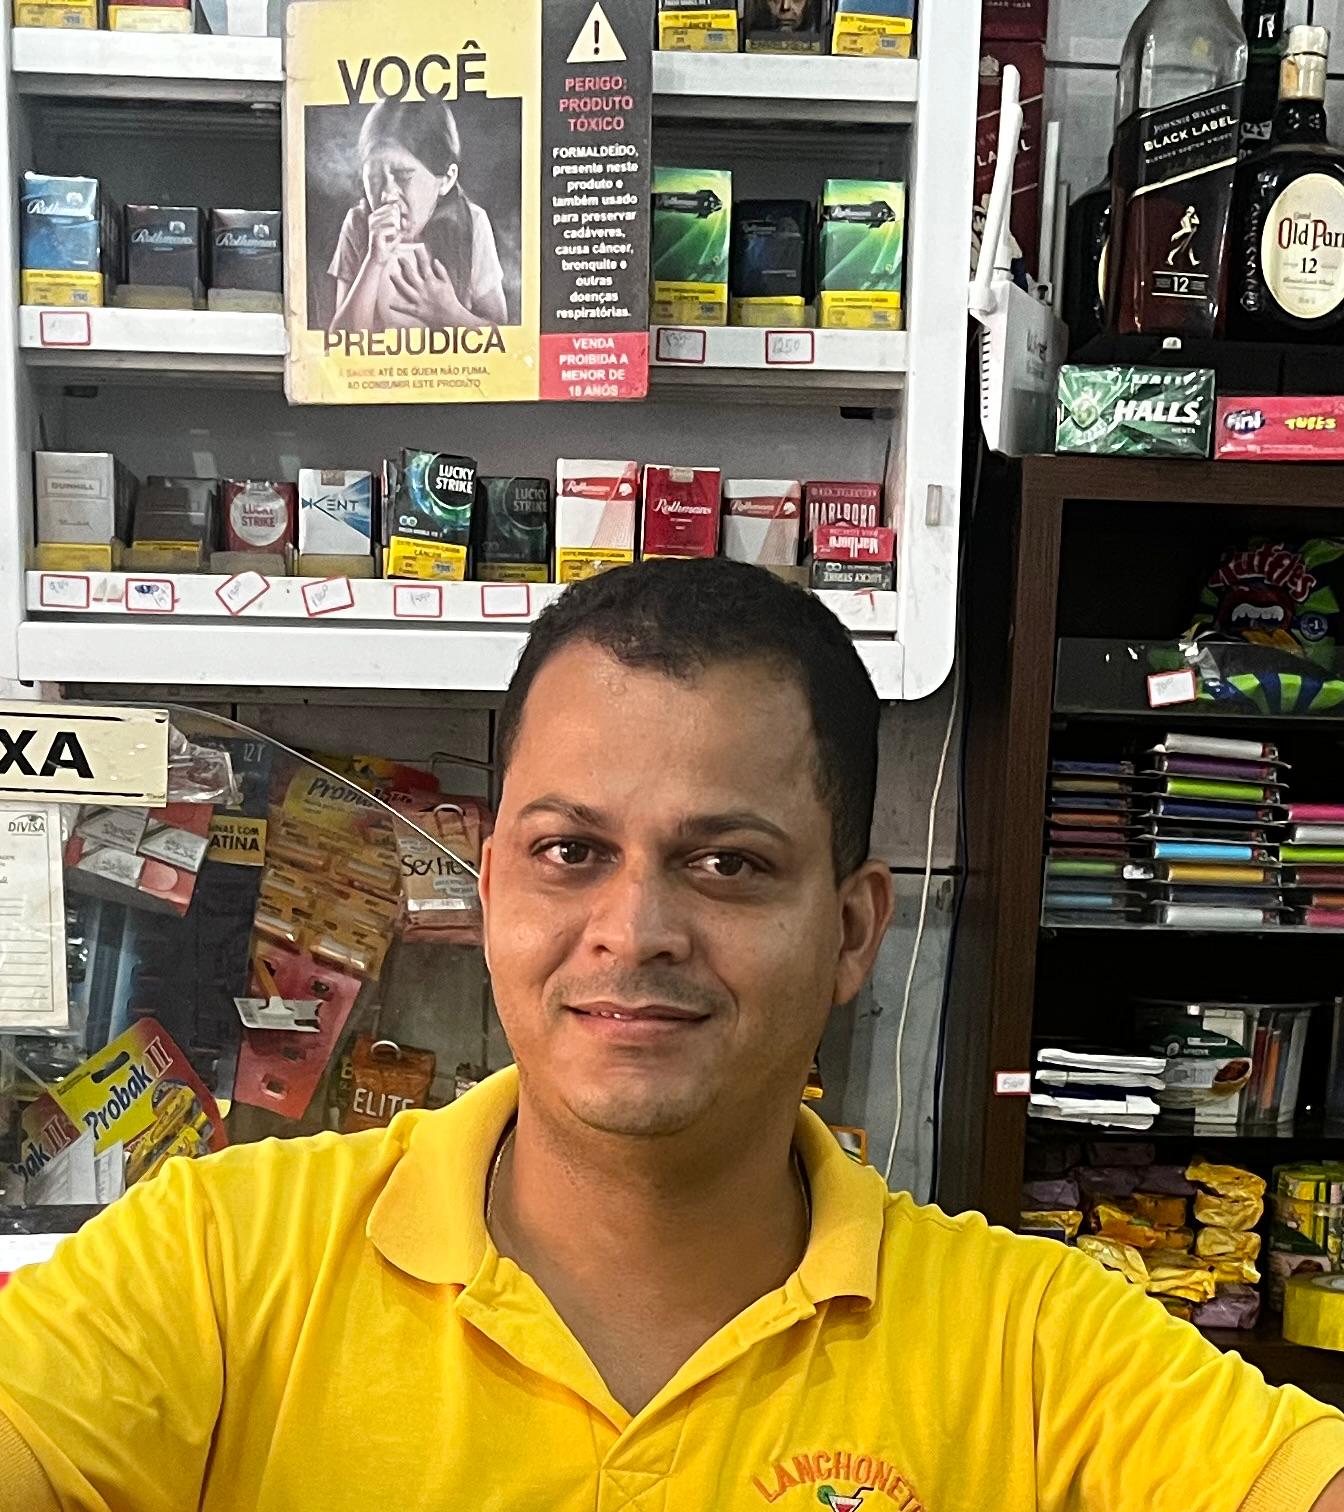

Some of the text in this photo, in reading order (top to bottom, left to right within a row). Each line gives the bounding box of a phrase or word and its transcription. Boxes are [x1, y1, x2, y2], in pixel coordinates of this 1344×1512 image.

[339, 39, 489, 101] VOCÊ
[565, 76, 628, 92] PERIGO:
[559, 96, 634, 112] PRODUTO
[567, 114, 625, 132] TÓXICO
[1143, 115, 1239, 152] BLACK LABEL
[552, 142, 639, 159] FORMALDEÍDO,
[552, 160, 639, 178] presente neste
[566, 178, 624, 193] produto e
[552, 193, 639, 207] também usado
[553, 210, 637, 226] para preservar
[131, 228, 194, 246] Rothmans
[215, 232, 278, 249] Rothmans
[563, 225, 626, 240] cadáveres,
[1278, 217, 1309, 250] Old
[555, 241, 635, 256] causa câncer,
[561, 257, 628, 273] bronquite e
[1299, 257, 1318, 275] 12
[575, 274, 613, 287] outras
[1173, 276, 1190, 293] 12
[569, 290, 620, 304] doenças
[556, 306, 632, 321] respiratórias.
[323, 326, 507, 357] PREJUDICA
[572, 337, 615, 350] VENDA
[559, 353, 630, 366] PROIBIDA A
[561, 368, 626, 382] MENOR DE
[568, 384, 620, 398] 18 ANOS
[439, 463, 475, 481] LUCKY
[435, 476, 474, 494] STRIKE
[514, 486, 548, 501] LUCKY
[242, 502, 274, 515] LUCKY
[513, 499, 548, 513] STRIKE
[654, 497, 714, 517] Rothmans
[241, 515, 276, 528] STRIKE
[809, 502, 877, 532] MARLBORO
[1207, 545, 1317, 602] Ruffles
[7, 820, 46, 833] DIVISA
[81, 1060, 152, 1142] Probak
